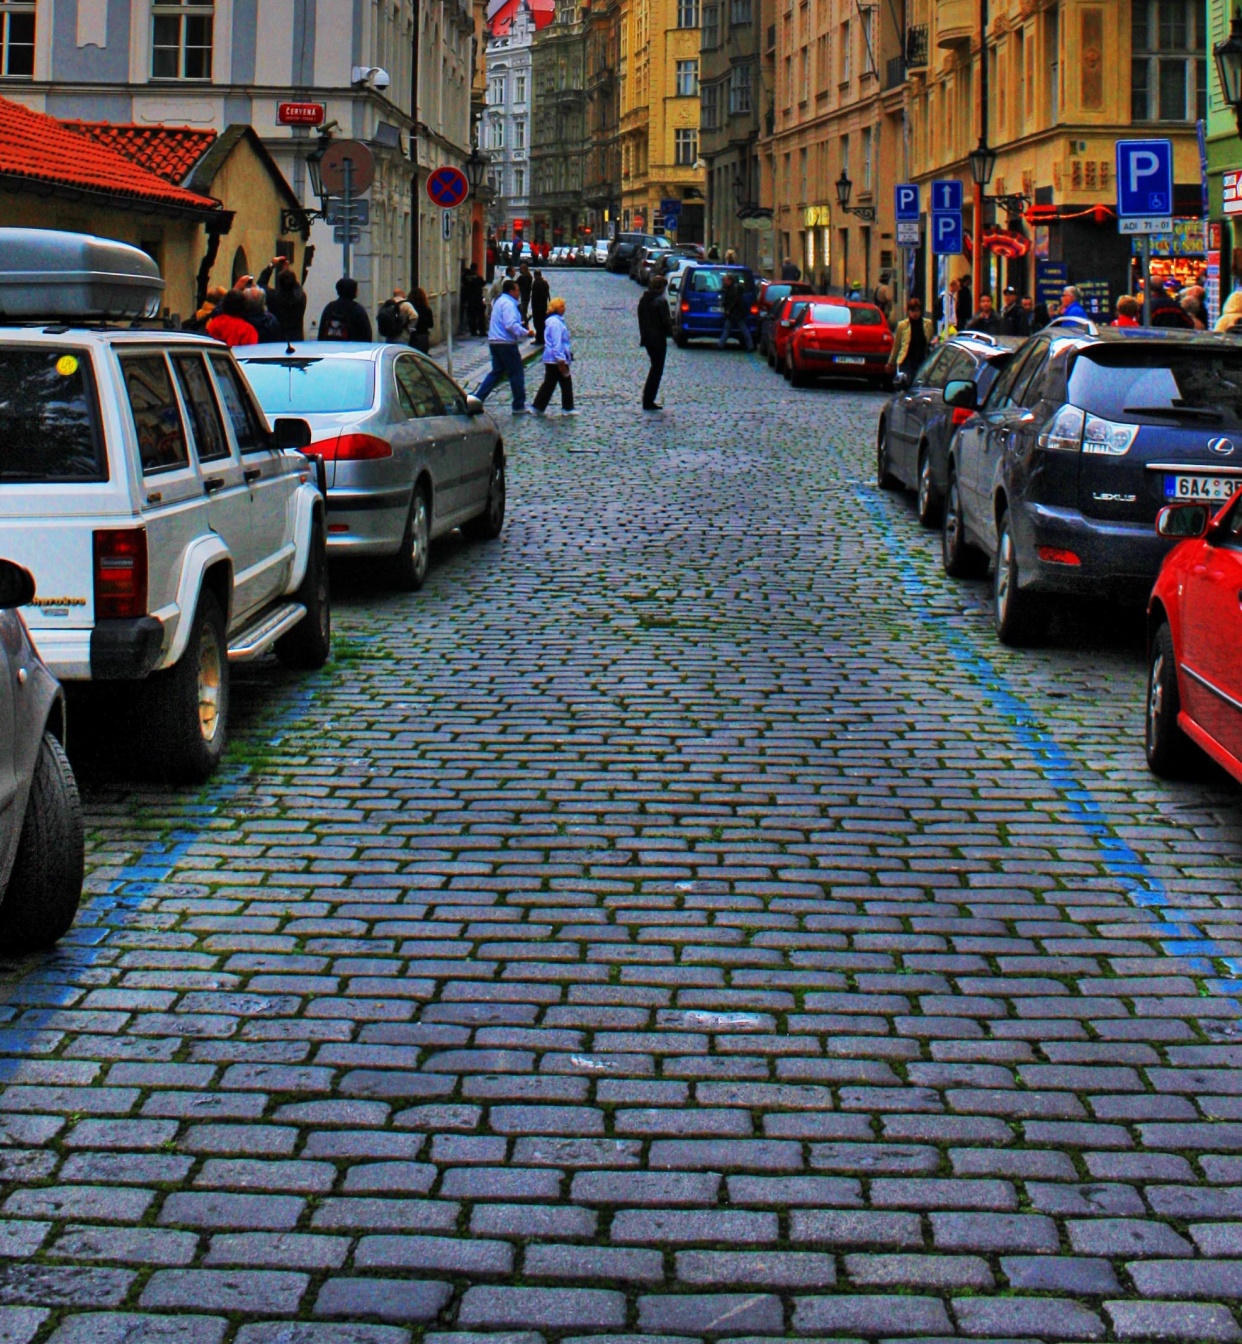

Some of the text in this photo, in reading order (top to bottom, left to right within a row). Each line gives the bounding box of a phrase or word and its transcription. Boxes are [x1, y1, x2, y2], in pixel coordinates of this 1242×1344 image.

[285, 106, 316, 116] ČERVENÁ
[1129, 151, 1160, 192] P
[900, 189, 915, 210] P
[939, 217, 956, 241] P
[1179, 478, 1210, 496] 6A4
[1093, 492, 1136, 502] LEXUS
